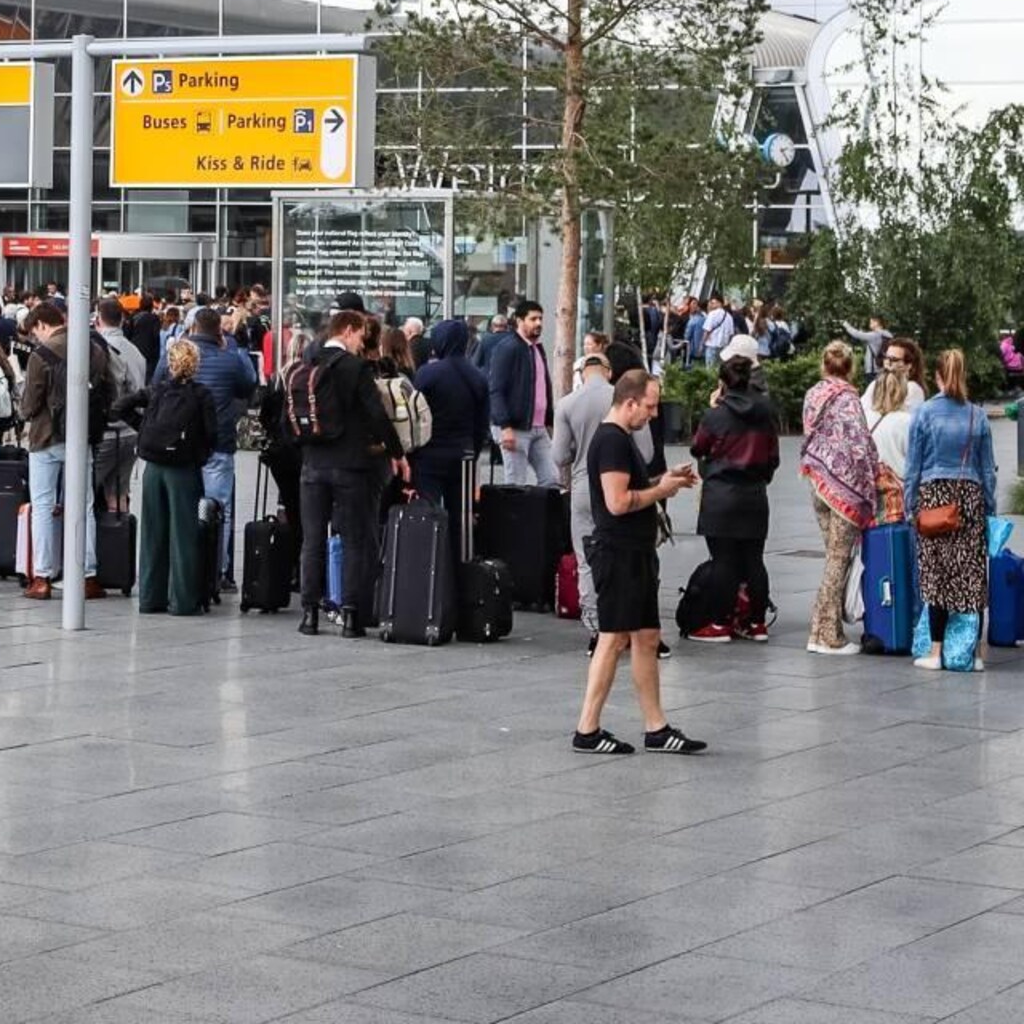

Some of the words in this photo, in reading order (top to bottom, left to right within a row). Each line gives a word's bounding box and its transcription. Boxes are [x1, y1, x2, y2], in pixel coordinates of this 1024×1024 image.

[179, 73, 239, 91] Parking
[143, 114, 187, 129] Buses
[228, 113, 286, 132] Parking
[196, 155, 227, 171] Kiss
[233, 155, 244, 171] &
[250, 155, 286, 171] Ride
